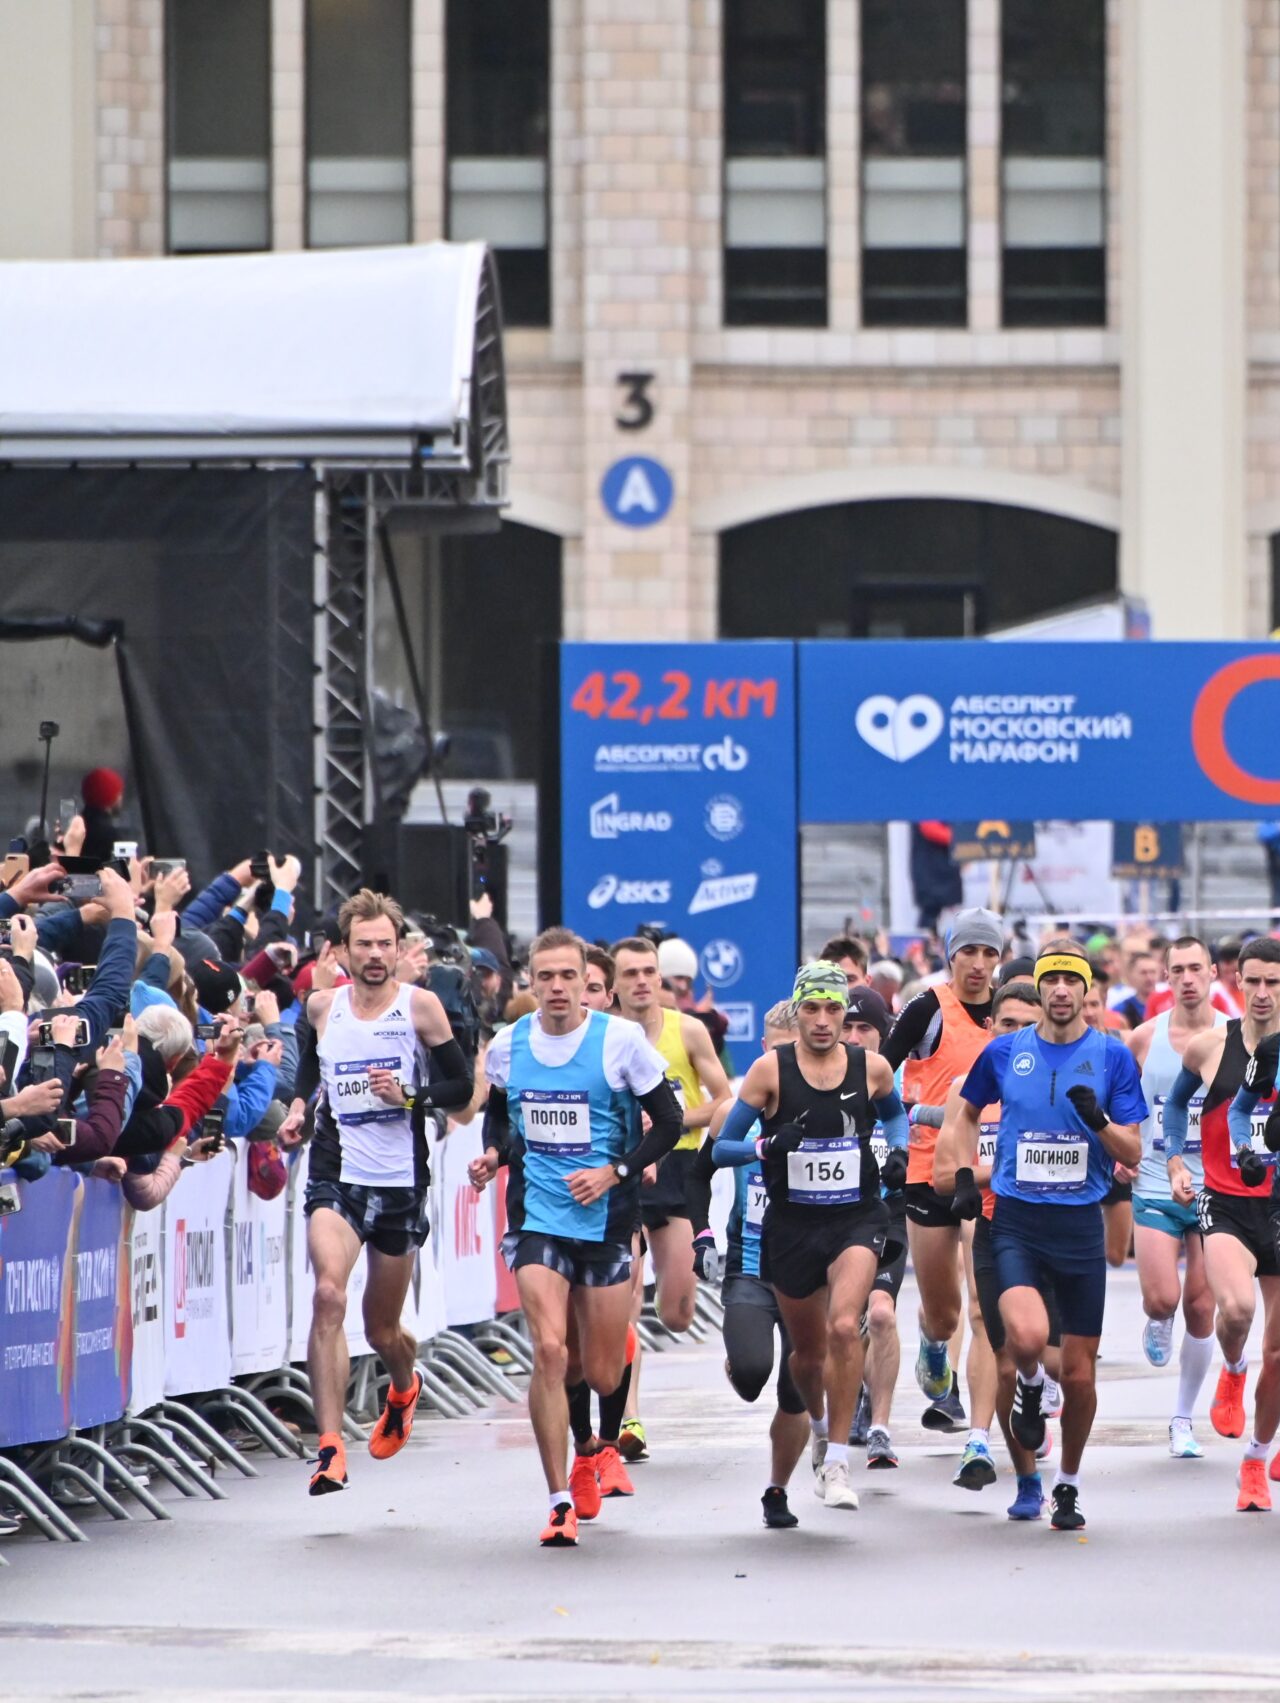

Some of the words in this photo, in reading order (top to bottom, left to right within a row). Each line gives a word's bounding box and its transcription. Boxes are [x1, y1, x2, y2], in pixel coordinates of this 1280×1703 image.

[616, 373, 655, 430] 3
[617, 465, 656, 513] A
[571, 671, 692, 725] 42,2
[703, 678, 777, 718] КМ
[950, 695, 1077, 714] АБСОЛЮТ
[949, 712, 1133, 740] МОСКОВСКИЙ
[595, 744, 702, 764] АБСОЛЮТ
[949, 740, 1078, 764] МАРАФОН
[596, 811, 673, 832] INGRAD
[615, 880, 672, 904] asics
[530, 1109, 578, 1126] ПОПОВ
[1024, 1148, 1080, 1165] ЛОГИНОВ
[804, 1161, 845, 1182] 156
